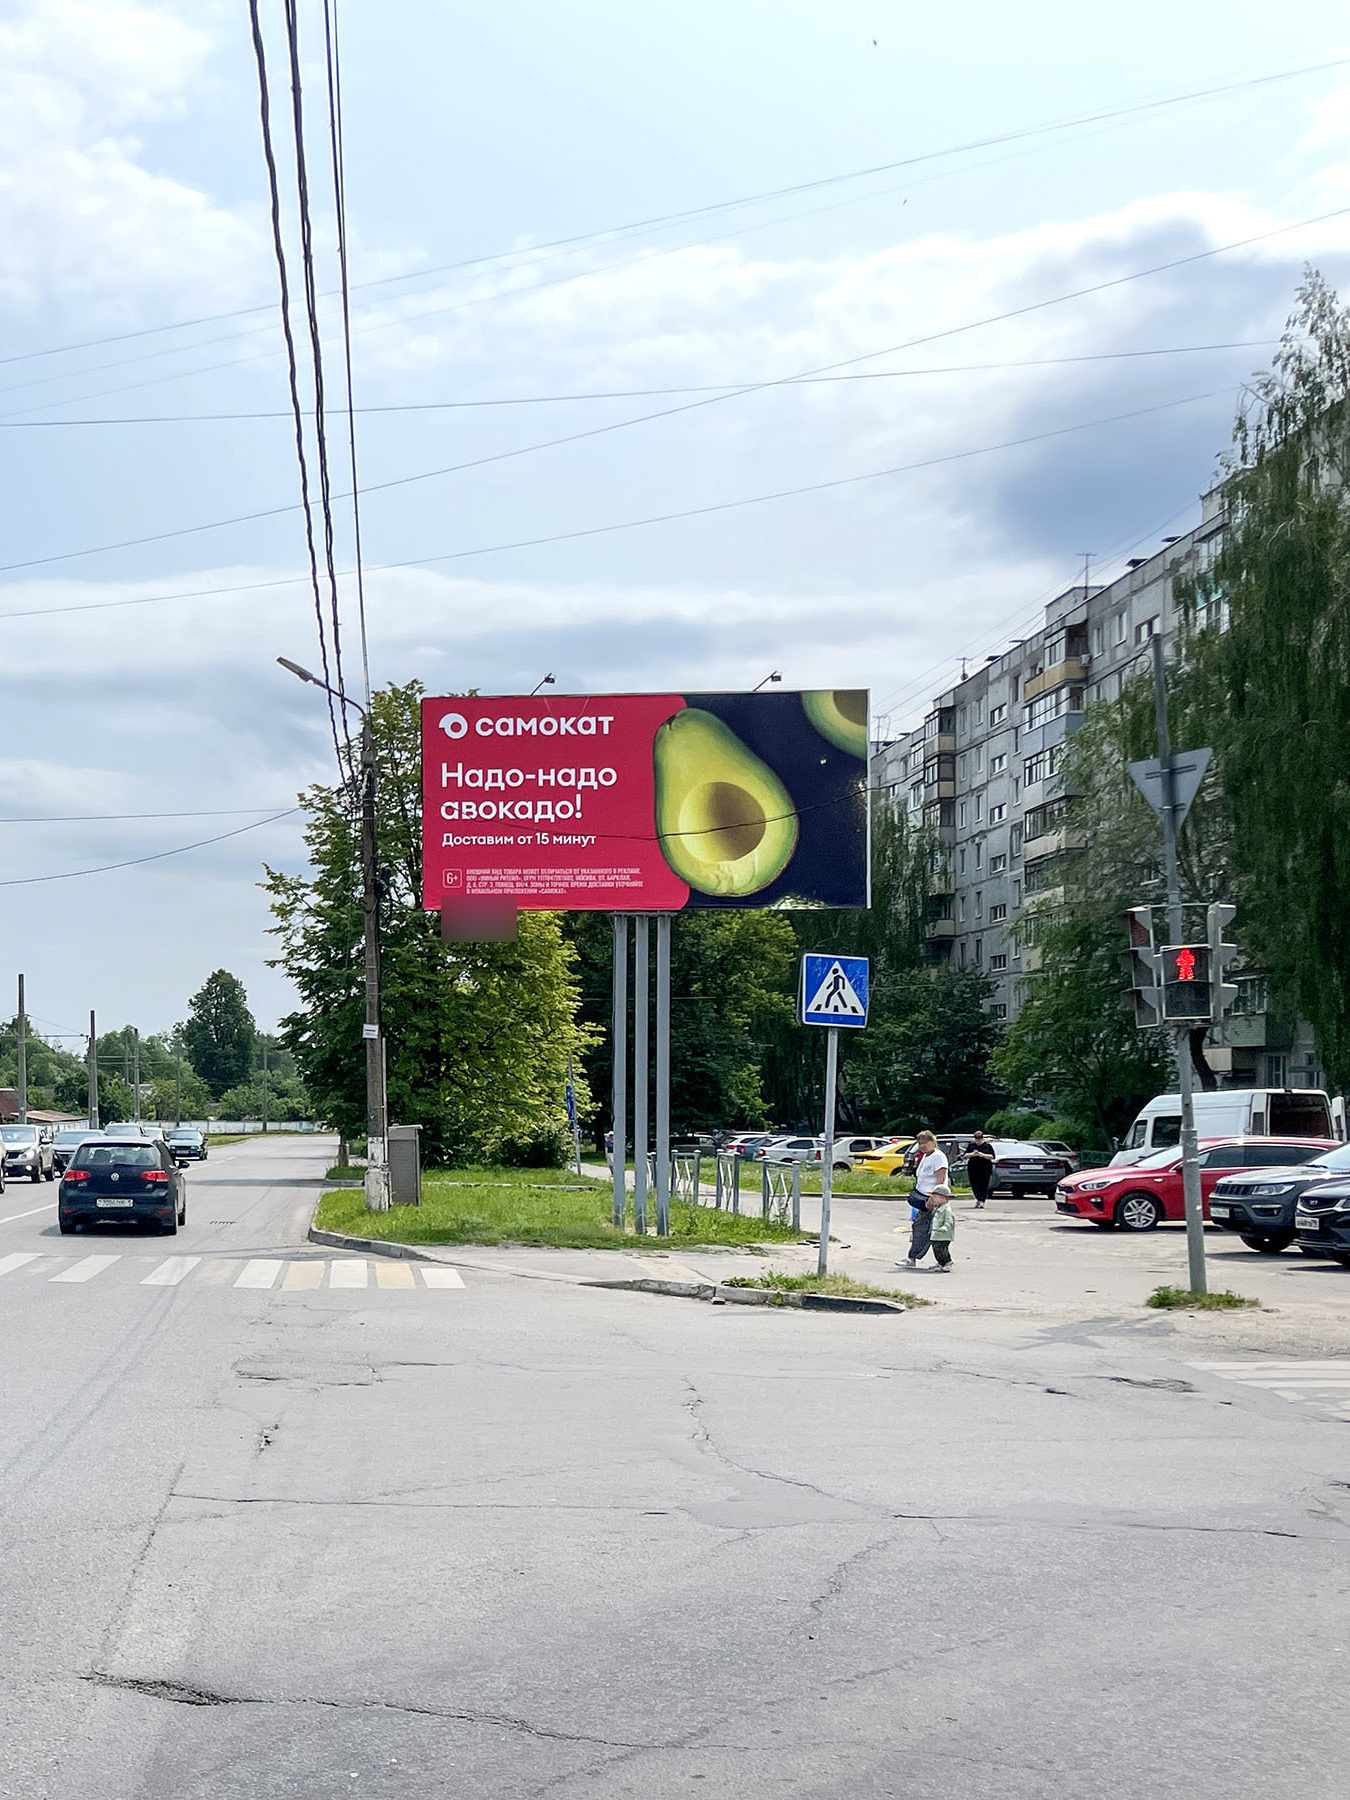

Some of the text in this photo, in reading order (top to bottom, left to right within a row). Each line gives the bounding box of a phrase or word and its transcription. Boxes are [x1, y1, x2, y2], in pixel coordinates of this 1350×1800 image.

[475, 716, 614, 736] самокат
[441, 762, 618, 791] Надо-надо
[440, 794, 583, 823] авокадо!
[442, 832, 597, 848] Доставим от 15 минут
[446, 872, 458, 884] 6+
